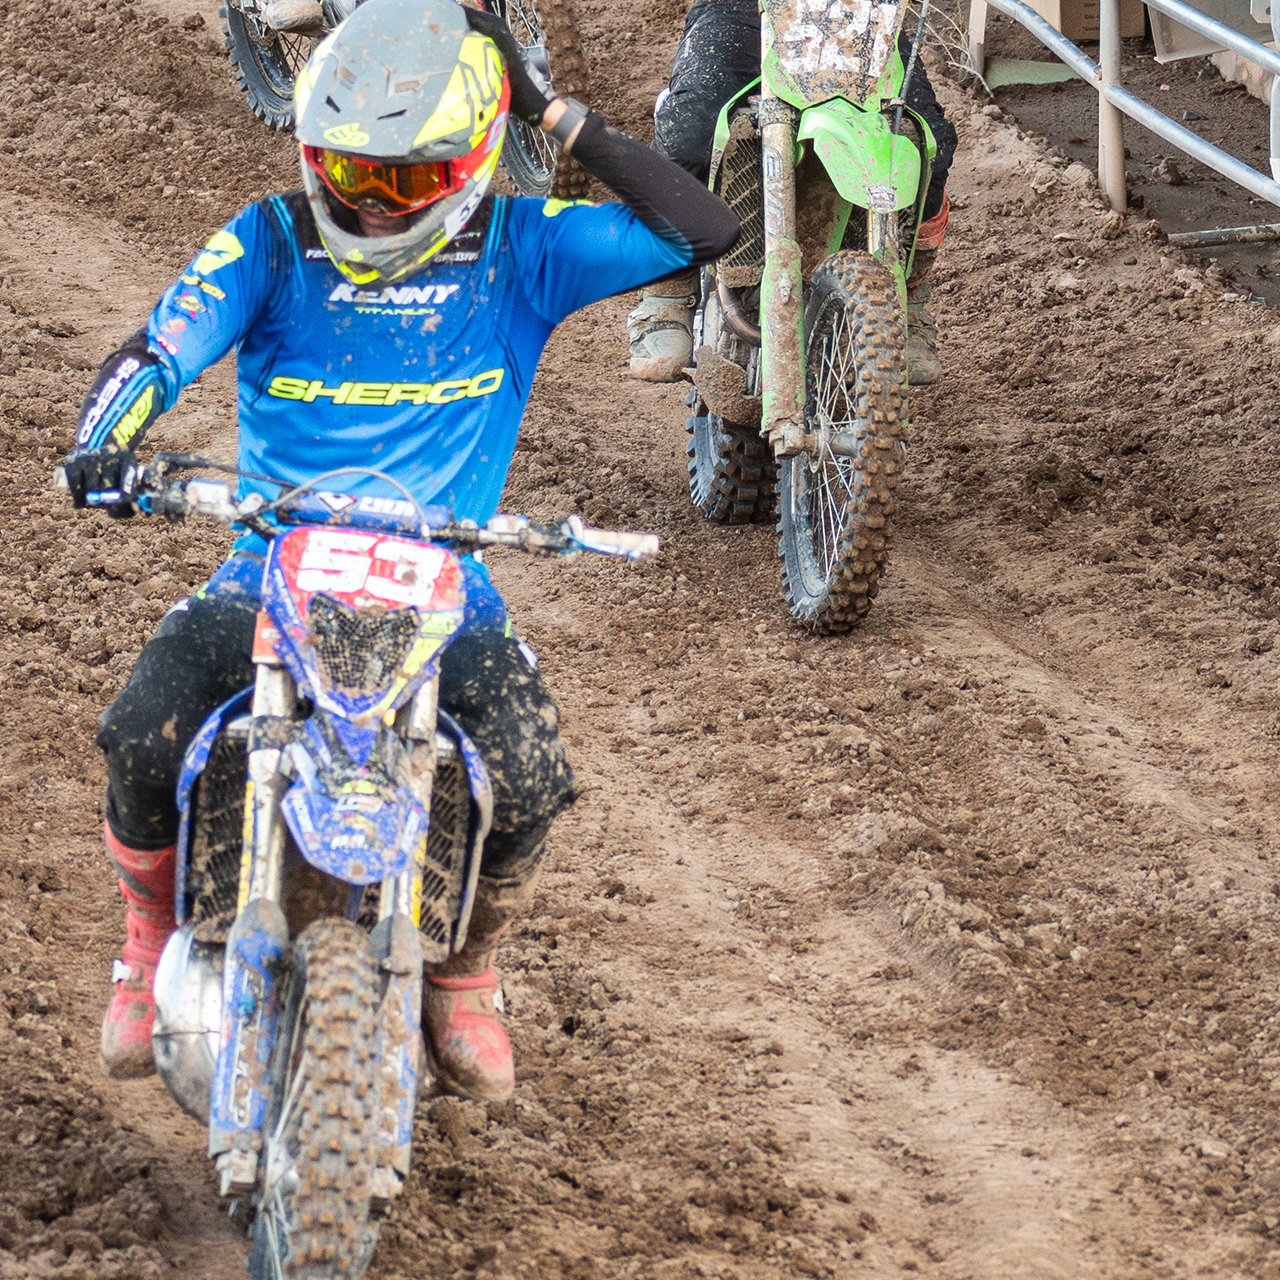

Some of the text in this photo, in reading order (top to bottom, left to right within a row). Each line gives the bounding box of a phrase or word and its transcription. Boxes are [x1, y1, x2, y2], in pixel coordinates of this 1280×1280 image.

[329, 283, 460, 304] KENNY
[268, 368, 504, 406] SHERCO
[296, 531, 447, 607] 53
